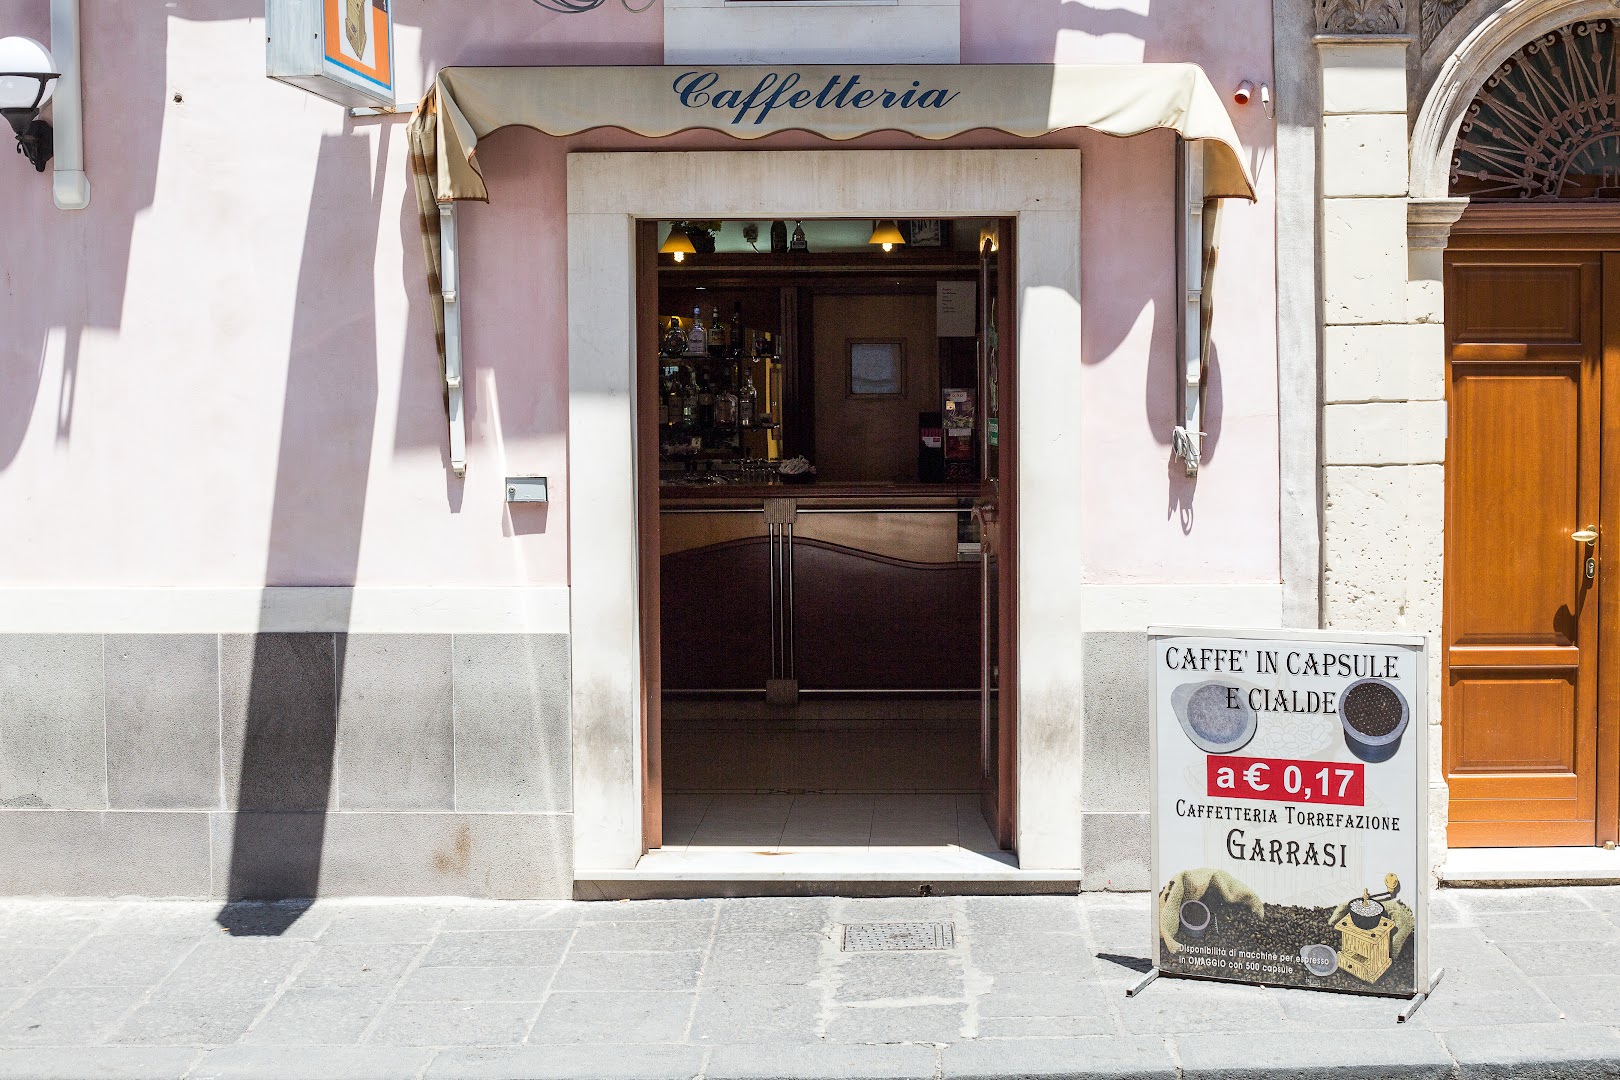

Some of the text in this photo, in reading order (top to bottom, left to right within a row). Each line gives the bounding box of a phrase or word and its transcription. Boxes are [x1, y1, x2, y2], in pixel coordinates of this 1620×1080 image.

[672, 71, 961, 125] Caffetteria
[1165, 646, 1400, 679] CAFFE' IN CAPSULE
[1226, 687, 1337, 715] E CIALDE
[1216, 762, 1355, 800] a € 0,17
[1176, 798, 1400, 831] CAFFETTERIA TORREFAZIONE
[1226, 828, 1347, 868] GARRASI
[1179, 944, 1330, 966] Disponibilità di macchine per espresso
[1179, 956, 1294, 974] in OMAGGIO con 500 capsule
